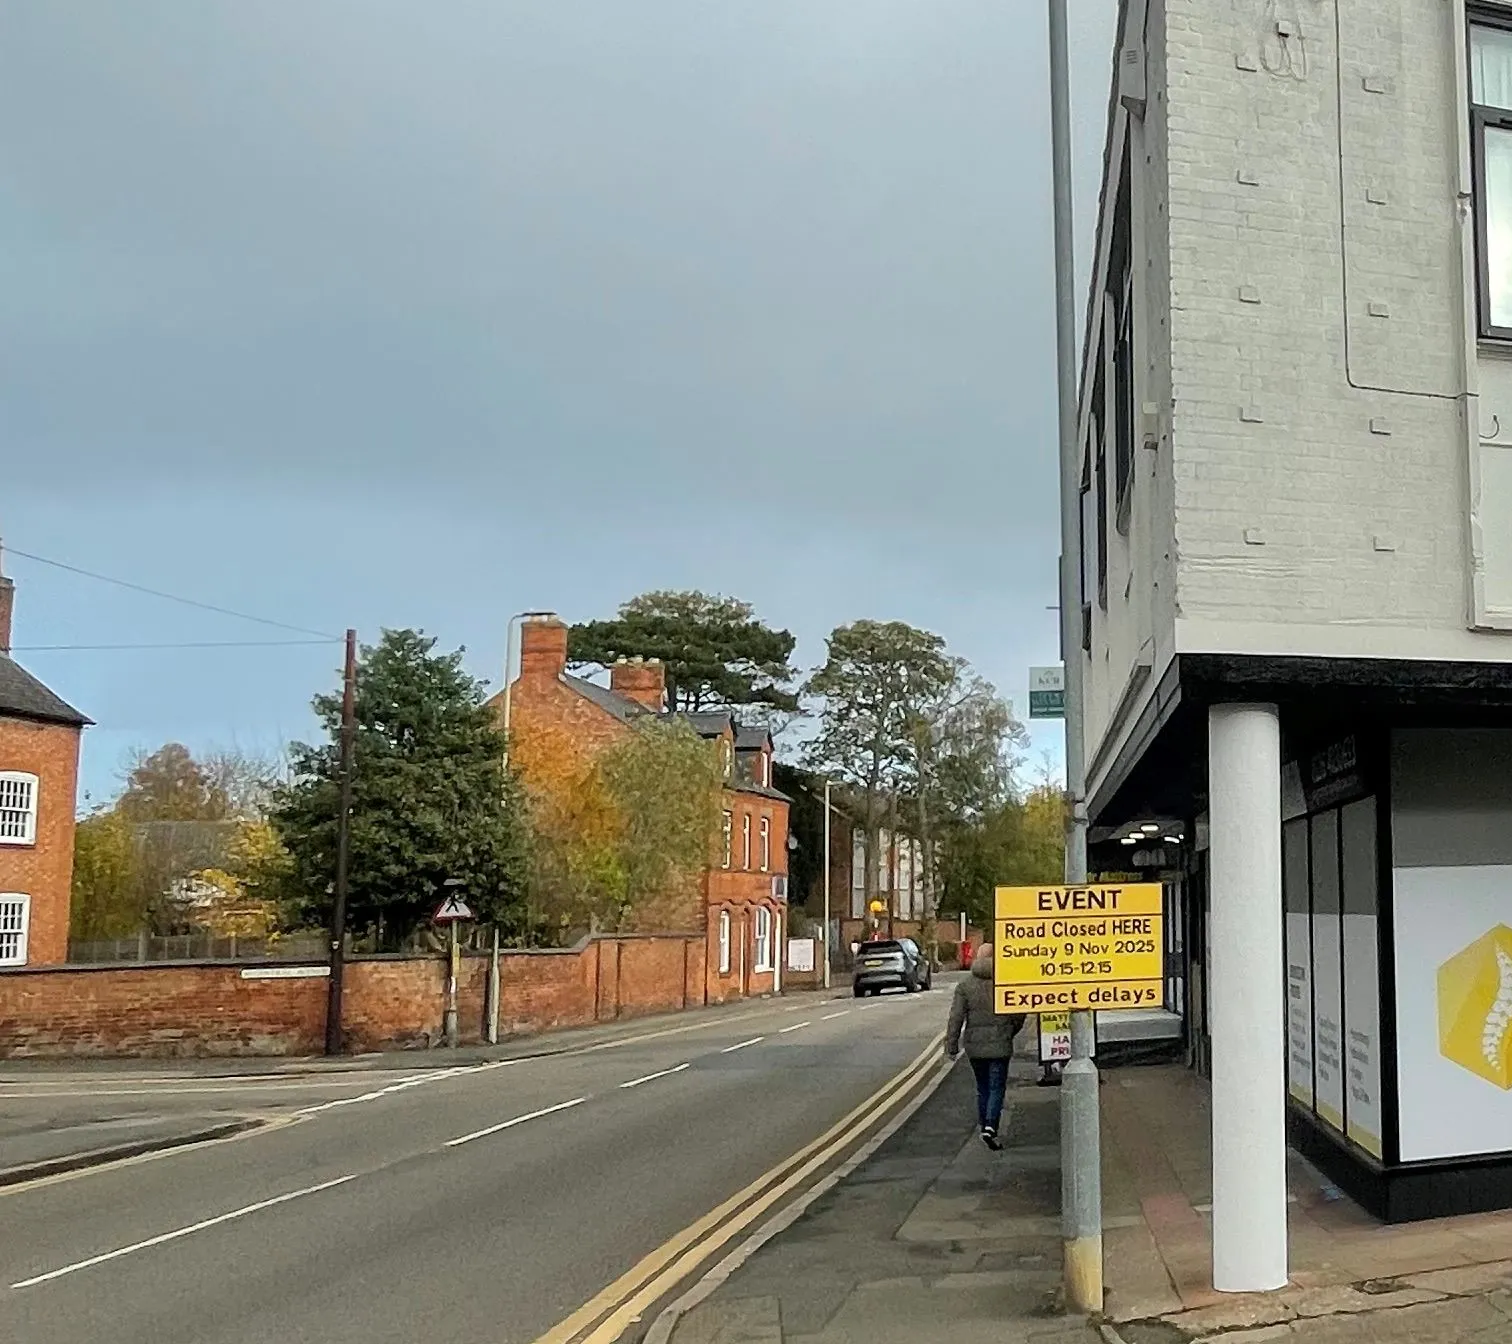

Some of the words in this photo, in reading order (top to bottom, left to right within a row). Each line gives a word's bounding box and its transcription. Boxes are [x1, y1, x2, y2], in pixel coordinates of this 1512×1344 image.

[1038, 889, 1122, 911] EVENT
[1005, 922, 1046, 939] Road
[1052, 920, 1106, 936] Closed
[1112, 919, 1151, 935] HERE
[1003, 944, 1057, 960] Sunday
[1064, 943, 1073, 955] 9
[1079, 942, 1109, 955] Nov
[1115, 940, 1155, 954] 2025
[1004, 989, 1078, 1008] Expect
[1088, 987, 1156, 1004] delays
